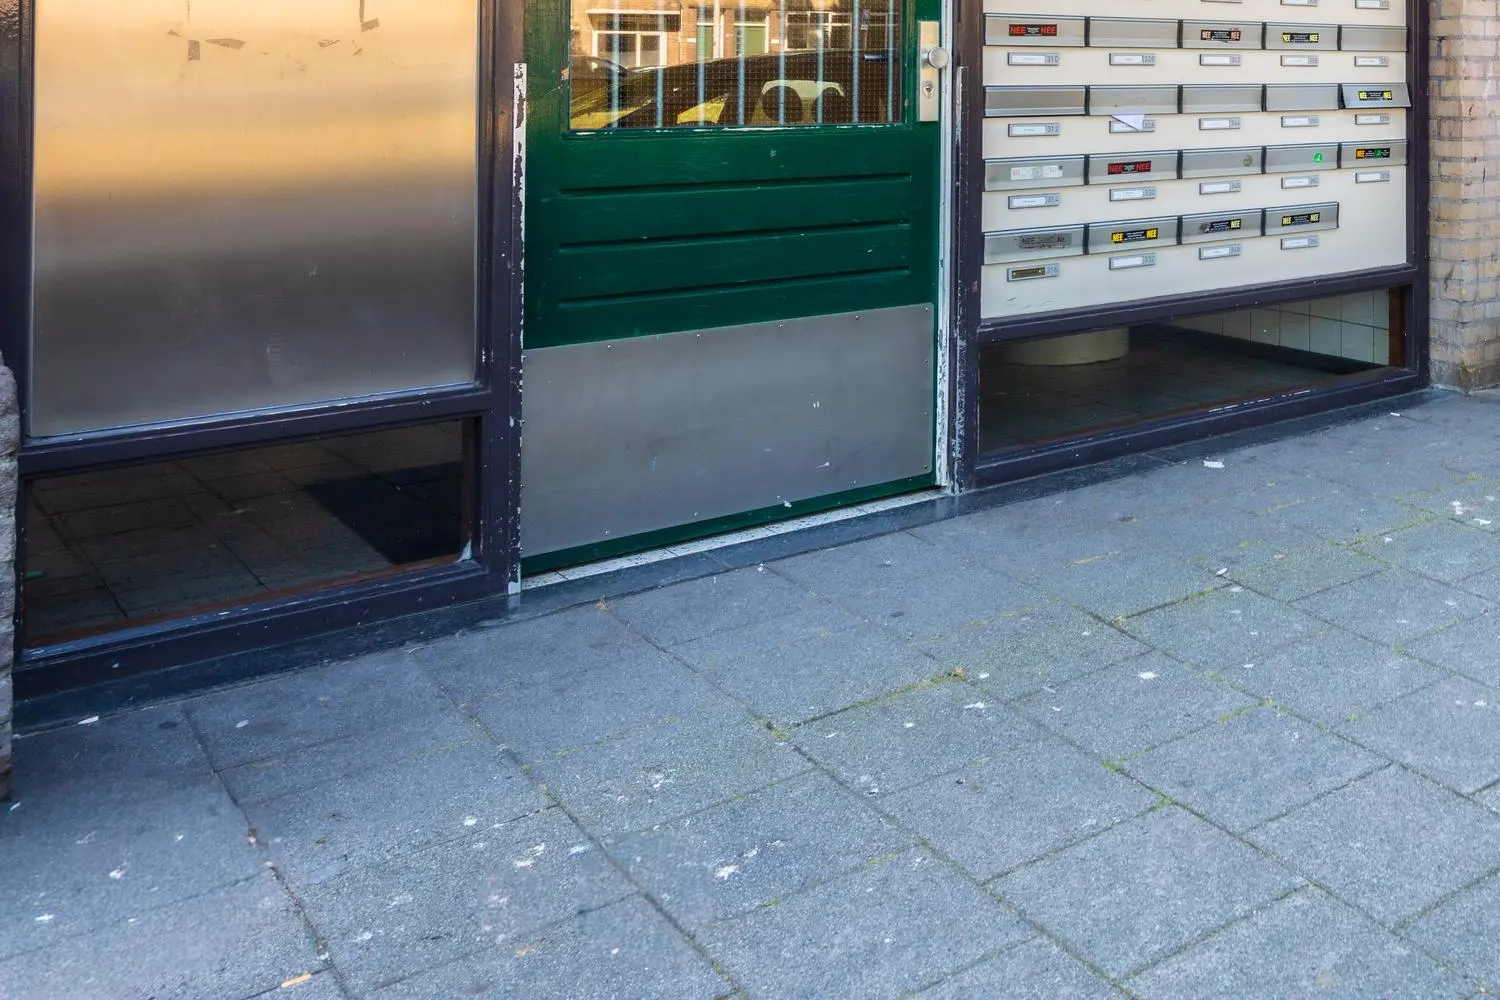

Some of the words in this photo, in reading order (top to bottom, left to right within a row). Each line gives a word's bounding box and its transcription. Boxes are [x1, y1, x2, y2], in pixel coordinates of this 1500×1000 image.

[1010, 26, 1026, 34] NEE
[1040, 26, 1057, 34] NEE
[1109, 165, 1123, 174] NEE
[1136, 162, 1151, 171] NEE
[1112, 233, 1123, 243] NEE
[1146, 229, 1158, 238] NEE
